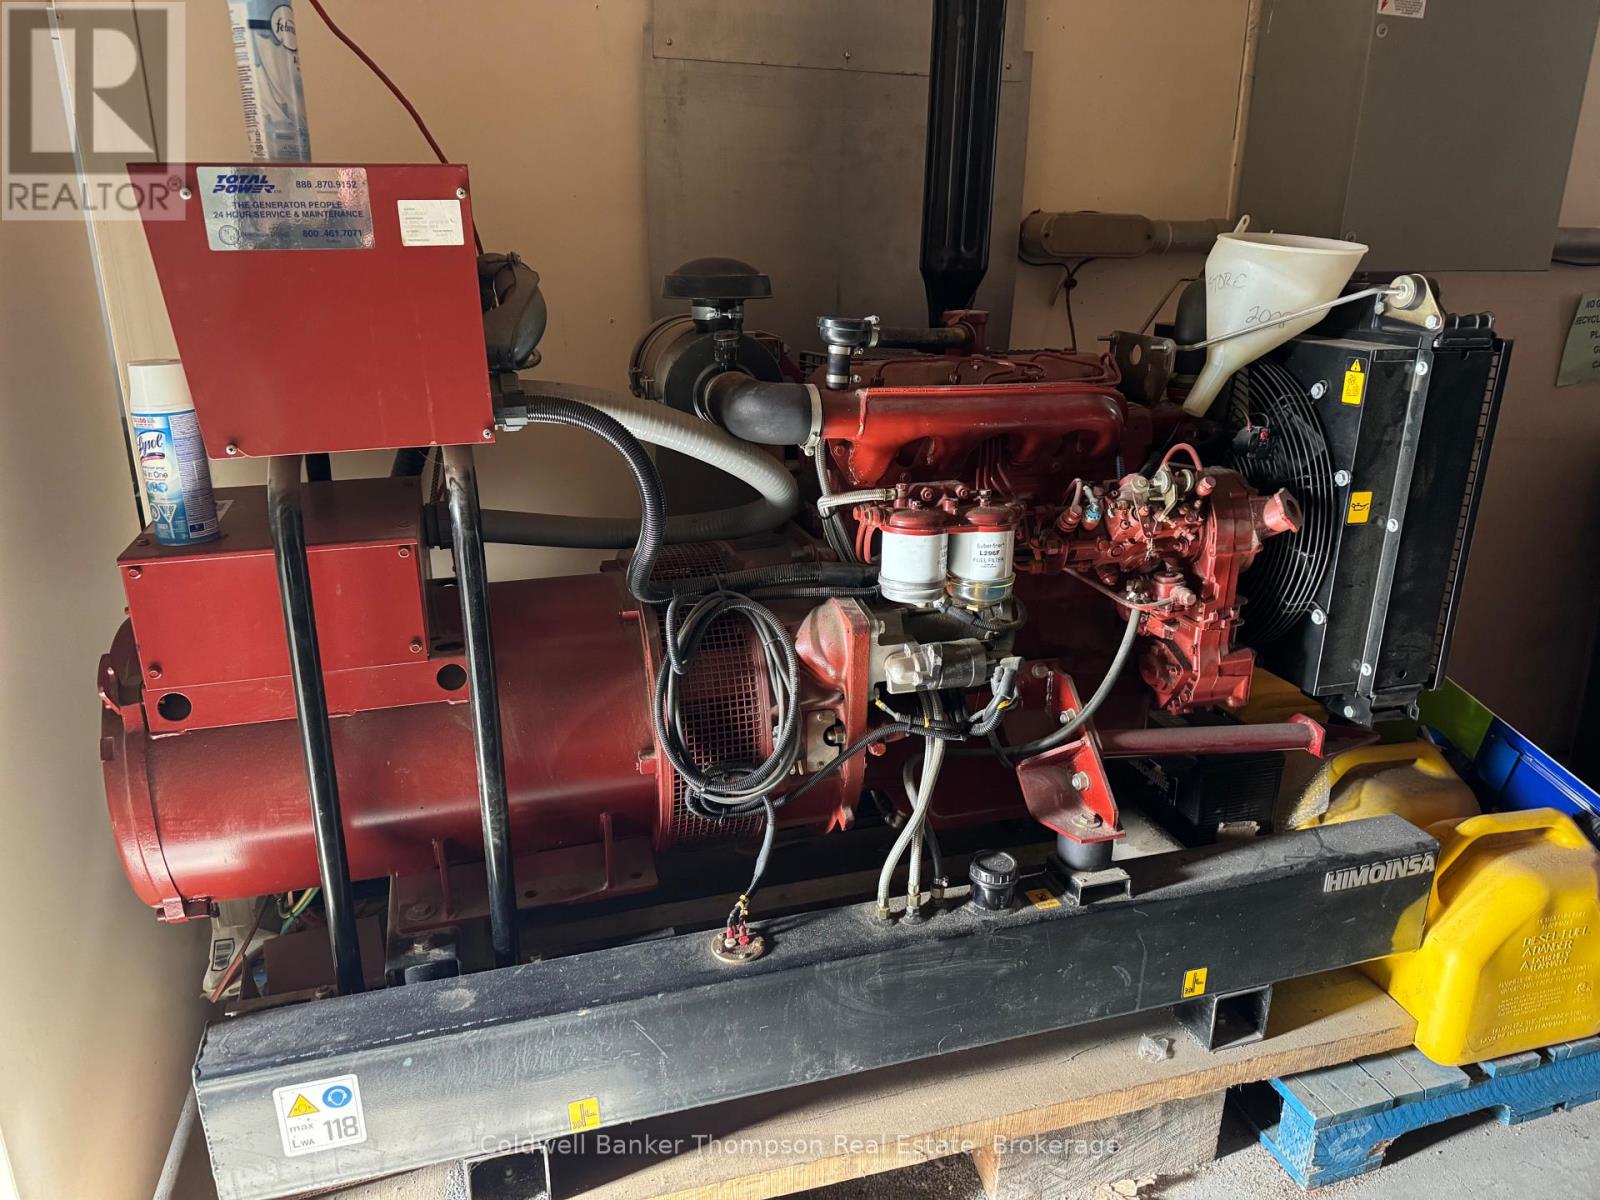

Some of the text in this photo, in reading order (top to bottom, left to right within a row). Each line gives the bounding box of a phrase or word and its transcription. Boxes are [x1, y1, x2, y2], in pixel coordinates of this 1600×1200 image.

[217, 174, 269, 184] TOTAL
[212, 184, 276, 194] POWER
[295, 180, 312, 189] 888
[233, 201, 343, 209] THE GENERATOR PEOPLE
[213, 210, 364, 219] 24 HOUR SERVICE & MAINTENANCE
[302, 229, 319, 237] 800
[154, 470, 168, 479] One
[1323, 851, 1435, 893] HIMOINSA
[289, 1115, 359, 1141] max 118
